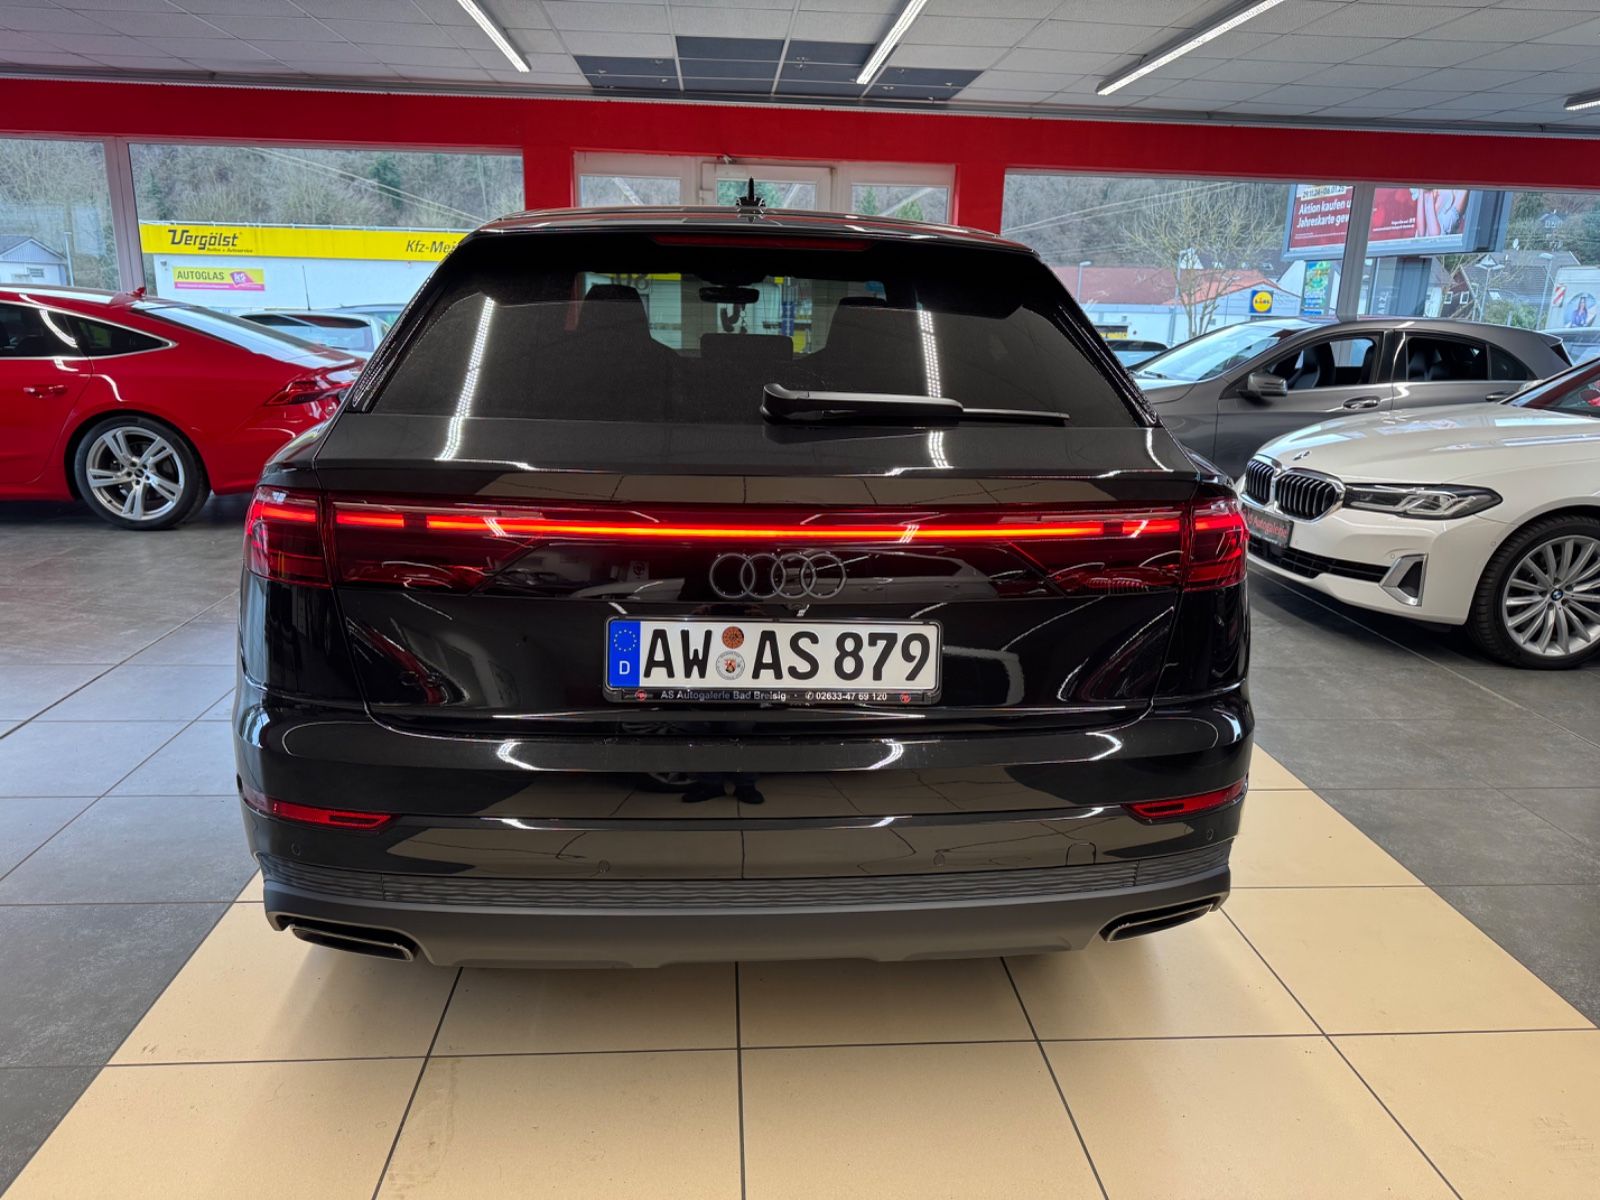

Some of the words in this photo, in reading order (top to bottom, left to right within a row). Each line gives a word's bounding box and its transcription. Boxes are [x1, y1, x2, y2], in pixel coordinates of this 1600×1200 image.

[1298, 202, 1320, 215] Aktion
[1321, 199, 1345, 212] kaufen
[1297, 214, 1335, 228] Jahreskarte
[168, 229, 238, 251] Vergölst
[177, 271, 224, 280] AUTOGLAS
[643, 629, 713, 679] AW
[752, 630, 819, 680] AS
[834, 631, 930, 681] 879
[619, 660, 630, 675] D
[660, 690, 674, 699] AS
[676, 690, 730, 701] Autogalerie
[733, 690, 751, 699] Bad
[754, 691, 786, 702] Breisig
[816, 691, 855, 700] 02633-47
[872, 692, 887, 700] 120
